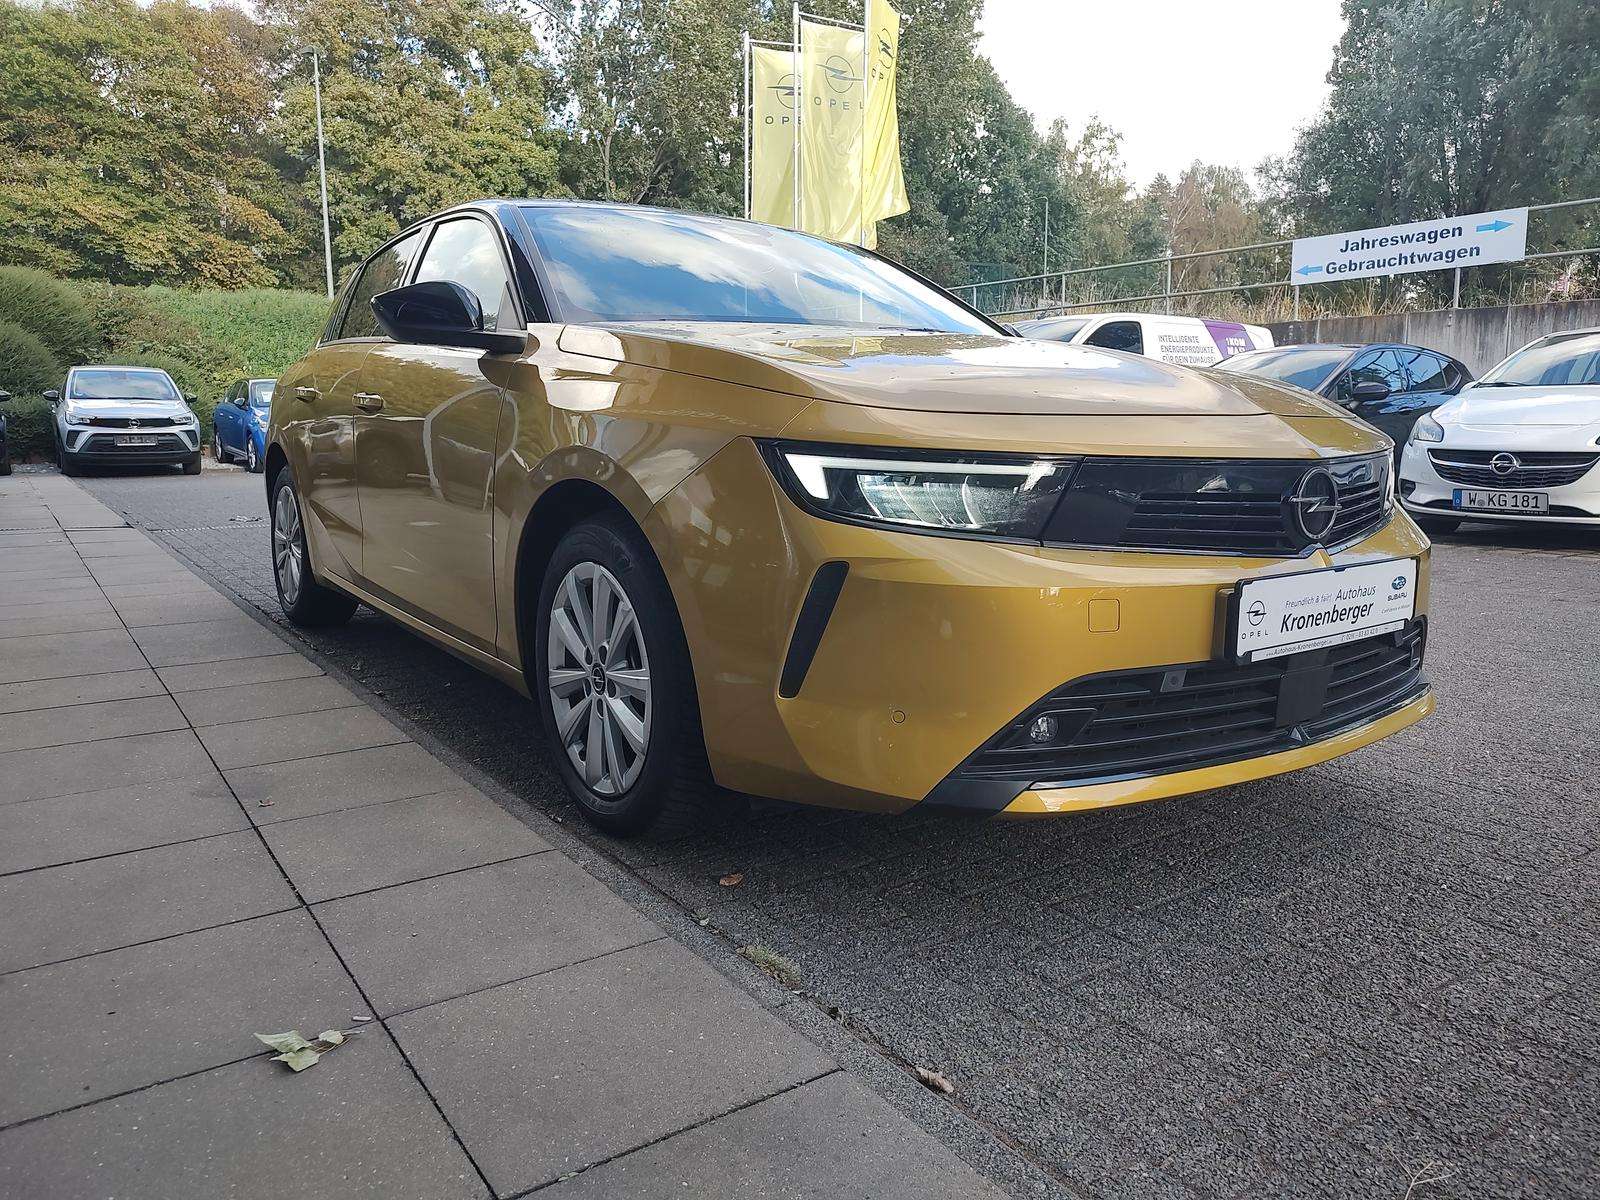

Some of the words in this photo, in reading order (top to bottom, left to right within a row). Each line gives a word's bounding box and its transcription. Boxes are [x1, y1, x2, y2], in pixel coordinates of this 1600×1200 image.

[814, 96, 864, 110] OPEL
[765, 115, 802, 125] OPE
[1340, 224, 1463, 253] Jahreswagen
[1326, 244, 1481, 275] Gebrauchtwagen
[1159, 335, 1199, 343] INTELLIGENTE
[1161, 345, 1214, 353] ENERGIEPRODUKTE
[1162, 354, 1173, 363] FÜR
[1175, 355, 1189, 363] DEIN
[1468, 492, 1478, 506] W
[1488, 493, 1507, 507] KG
[1511, 494, 1540, 509] 181
[1285, 596, 1314, 609] Freundlich
[1335, 585, 1376, 602] Autohaus
[1387, 592, 1407, 601] SUBARU
[1280, 602, 1375, 634] Kronenberger
[1241, 629, 1269, 640] OPEL
